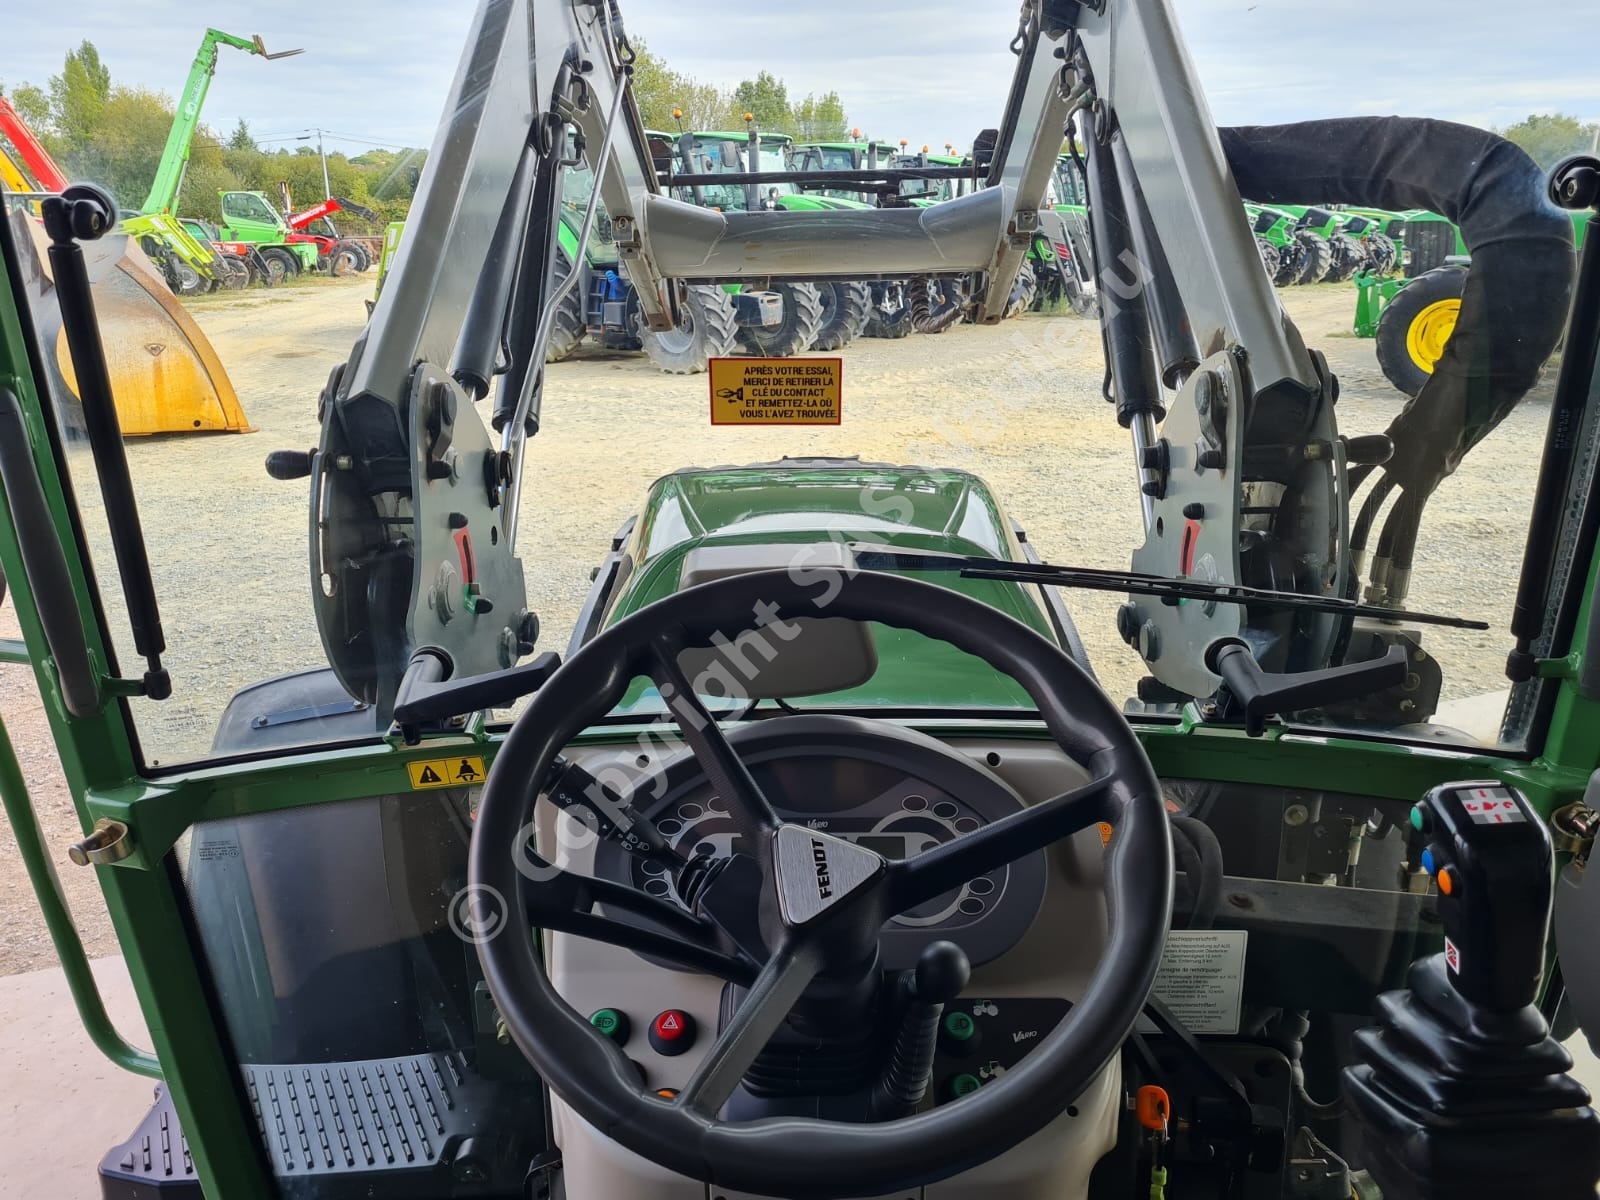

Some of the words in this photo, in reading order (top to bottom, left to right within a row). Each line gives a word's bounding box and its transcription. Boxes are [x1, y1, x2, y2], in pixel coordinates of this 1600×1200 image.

[744, 365, 773, 375] APRÈS
[775, 366, 805, 375] VOTRE
[805, 366, 833, 377] ESSAI,
[743, 377, 771, 386] MERCI
[772, 377, 784, 386] DE
[785, 377, 821, 386] RETIRER
[823, 377, 834, 386] LA
[752, 387, 768, 396] CLÉ
[770, 388, 782, 396] DU
[783, 388, 825, 396] CONTACT
[745, 399, 756, 407] ET
[758, 399, 818, 407] REMETTEZ-LA
[739, 410, 763, 418] VOUS
[765, 410, 794, 418] L'AVEZ
[811, 838, 832, 899] FENDT
